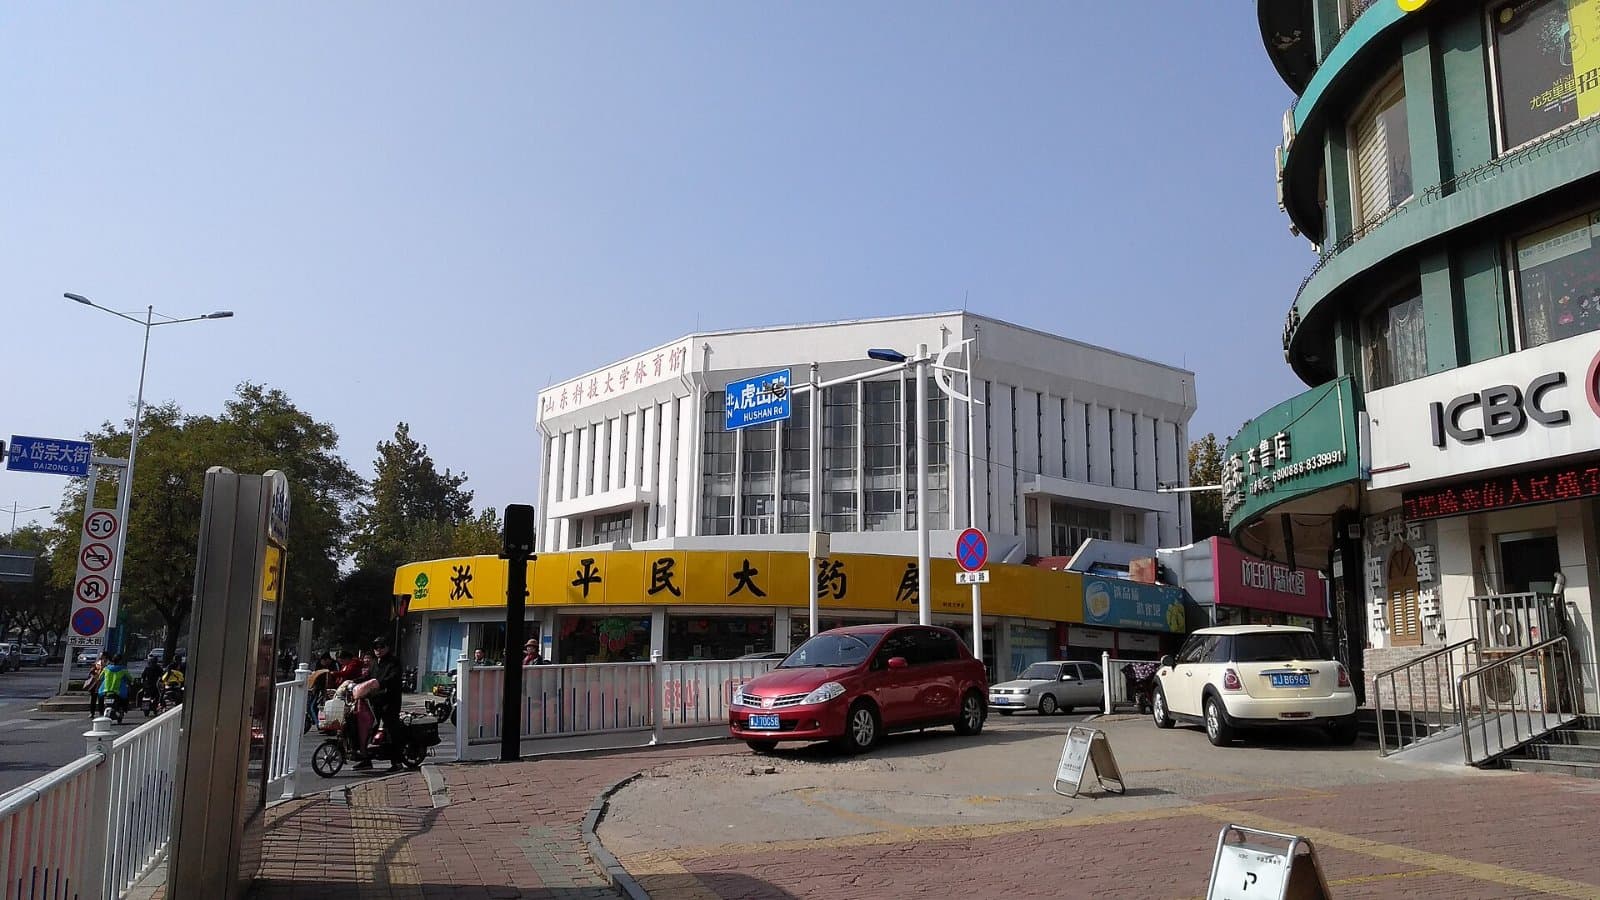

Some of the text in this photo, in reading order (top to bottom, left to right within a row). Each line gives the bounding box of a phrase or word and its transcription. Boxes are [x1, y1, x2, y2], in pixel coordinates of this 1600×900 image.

[1577, 68, 1600, 95] 招
[1529, 79, 1577, 110] 尤克里里
[545, 346, 686, 413] 山东科技大学体育馆
[727, 392, 735, 407] 北
[1429, 371, 1571, 448] ICBC
[727, 408, 733, 419] N
[743, 405, 783, 422] HUSHAN Rd
[30, 442, 89, 464] 岱宗大街
[1247, 431, 1289, 476] 齐鲁店
[1305, 450, 1342, 470] 8339991
[33, 462, 69, 472] DAIZONG
[90, 519, 113, 533] 50
[450, 557, 922, 606] 漱平民大药房
